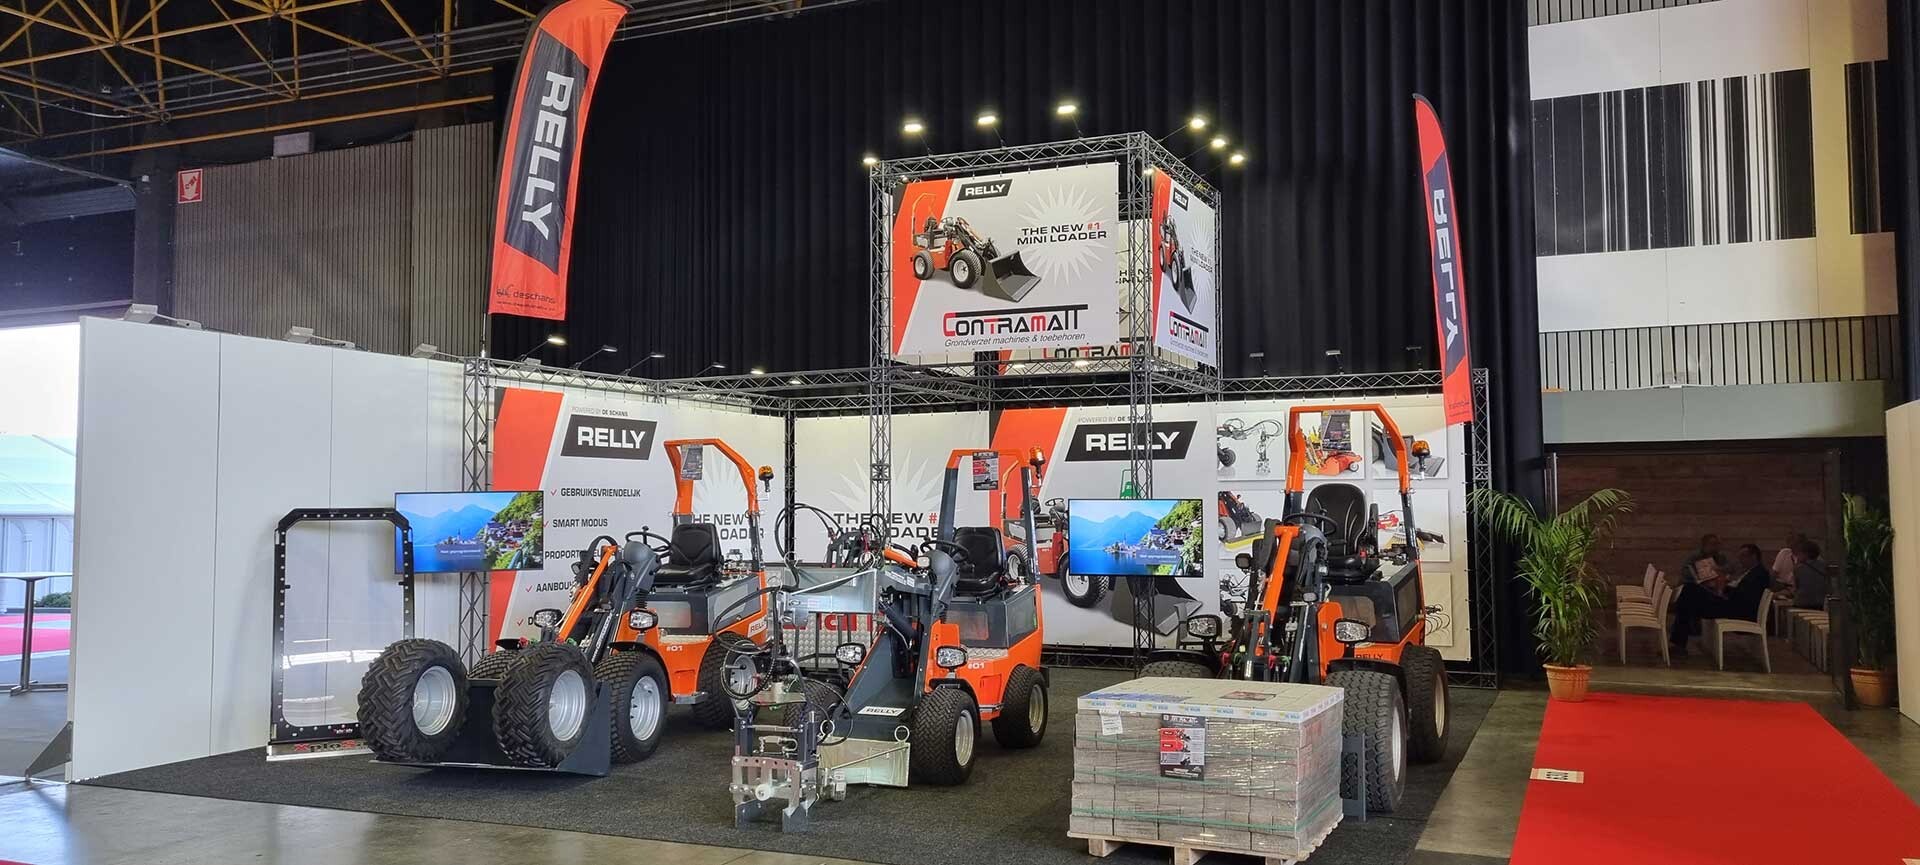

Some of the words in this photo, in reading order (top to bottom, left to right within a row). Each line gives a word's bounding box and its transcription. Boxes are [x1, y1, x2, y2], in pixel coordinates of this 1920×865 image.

[522, 70, 574, 240] RELLY
[965, 184, 1006, 197] RELLY
[1021, 226, 1048, 236] THE
[1051, 223, 1084, 234] NEW
[1087, 222, 1101, 231] #1
[1017, 235, 1047, 246] MINI
[1050, 231, 1107, 243] LOADER
[944, 337, 991, 347] Grondverzet
[992, 335, 1032, 345] machines
[1039, 333, 1086, 342] toebehoren
[577, 426, 646, 449] RELLY
[560, 488, 641, 497] GEBRUIKSVRIENDELIJK
[553, 519, 579, 528] SMART
[581, 518, 608, 527] MODUS
[714, 514, 744, 525] NEW
